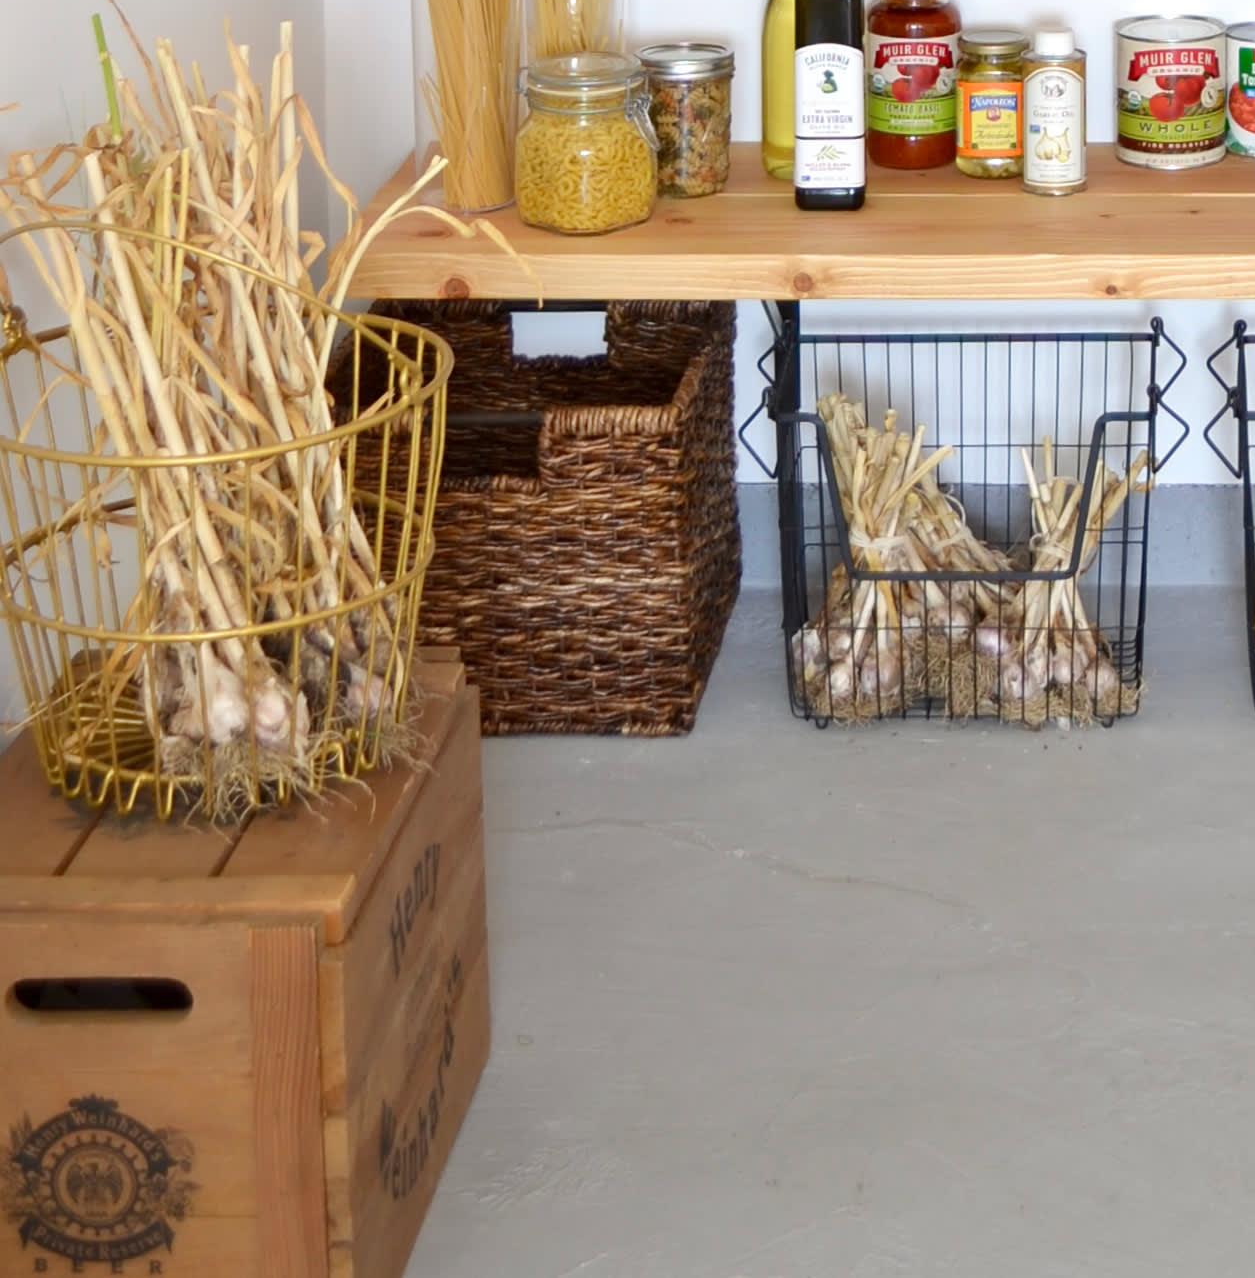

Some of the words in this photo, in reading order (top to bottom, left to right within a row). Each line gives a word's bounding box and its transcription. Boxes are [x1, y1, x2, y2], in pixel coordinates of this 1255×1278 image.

[882, 44, 912, 57] MUIR
[916, 44, 947, 57] GLEN
[804, 52, 851, 66] CALIFORNIA
[1138, 52, 1174, 67] MUIR
[1179, 50, 1212, 65] GLEN
[802, 114, 826, 124] EXTRA
[826, 114, 854, 124] VIRGIN
[1138, 119, 1212, 133] WHOLE
[33, 1257, 164, 1275] BEER
